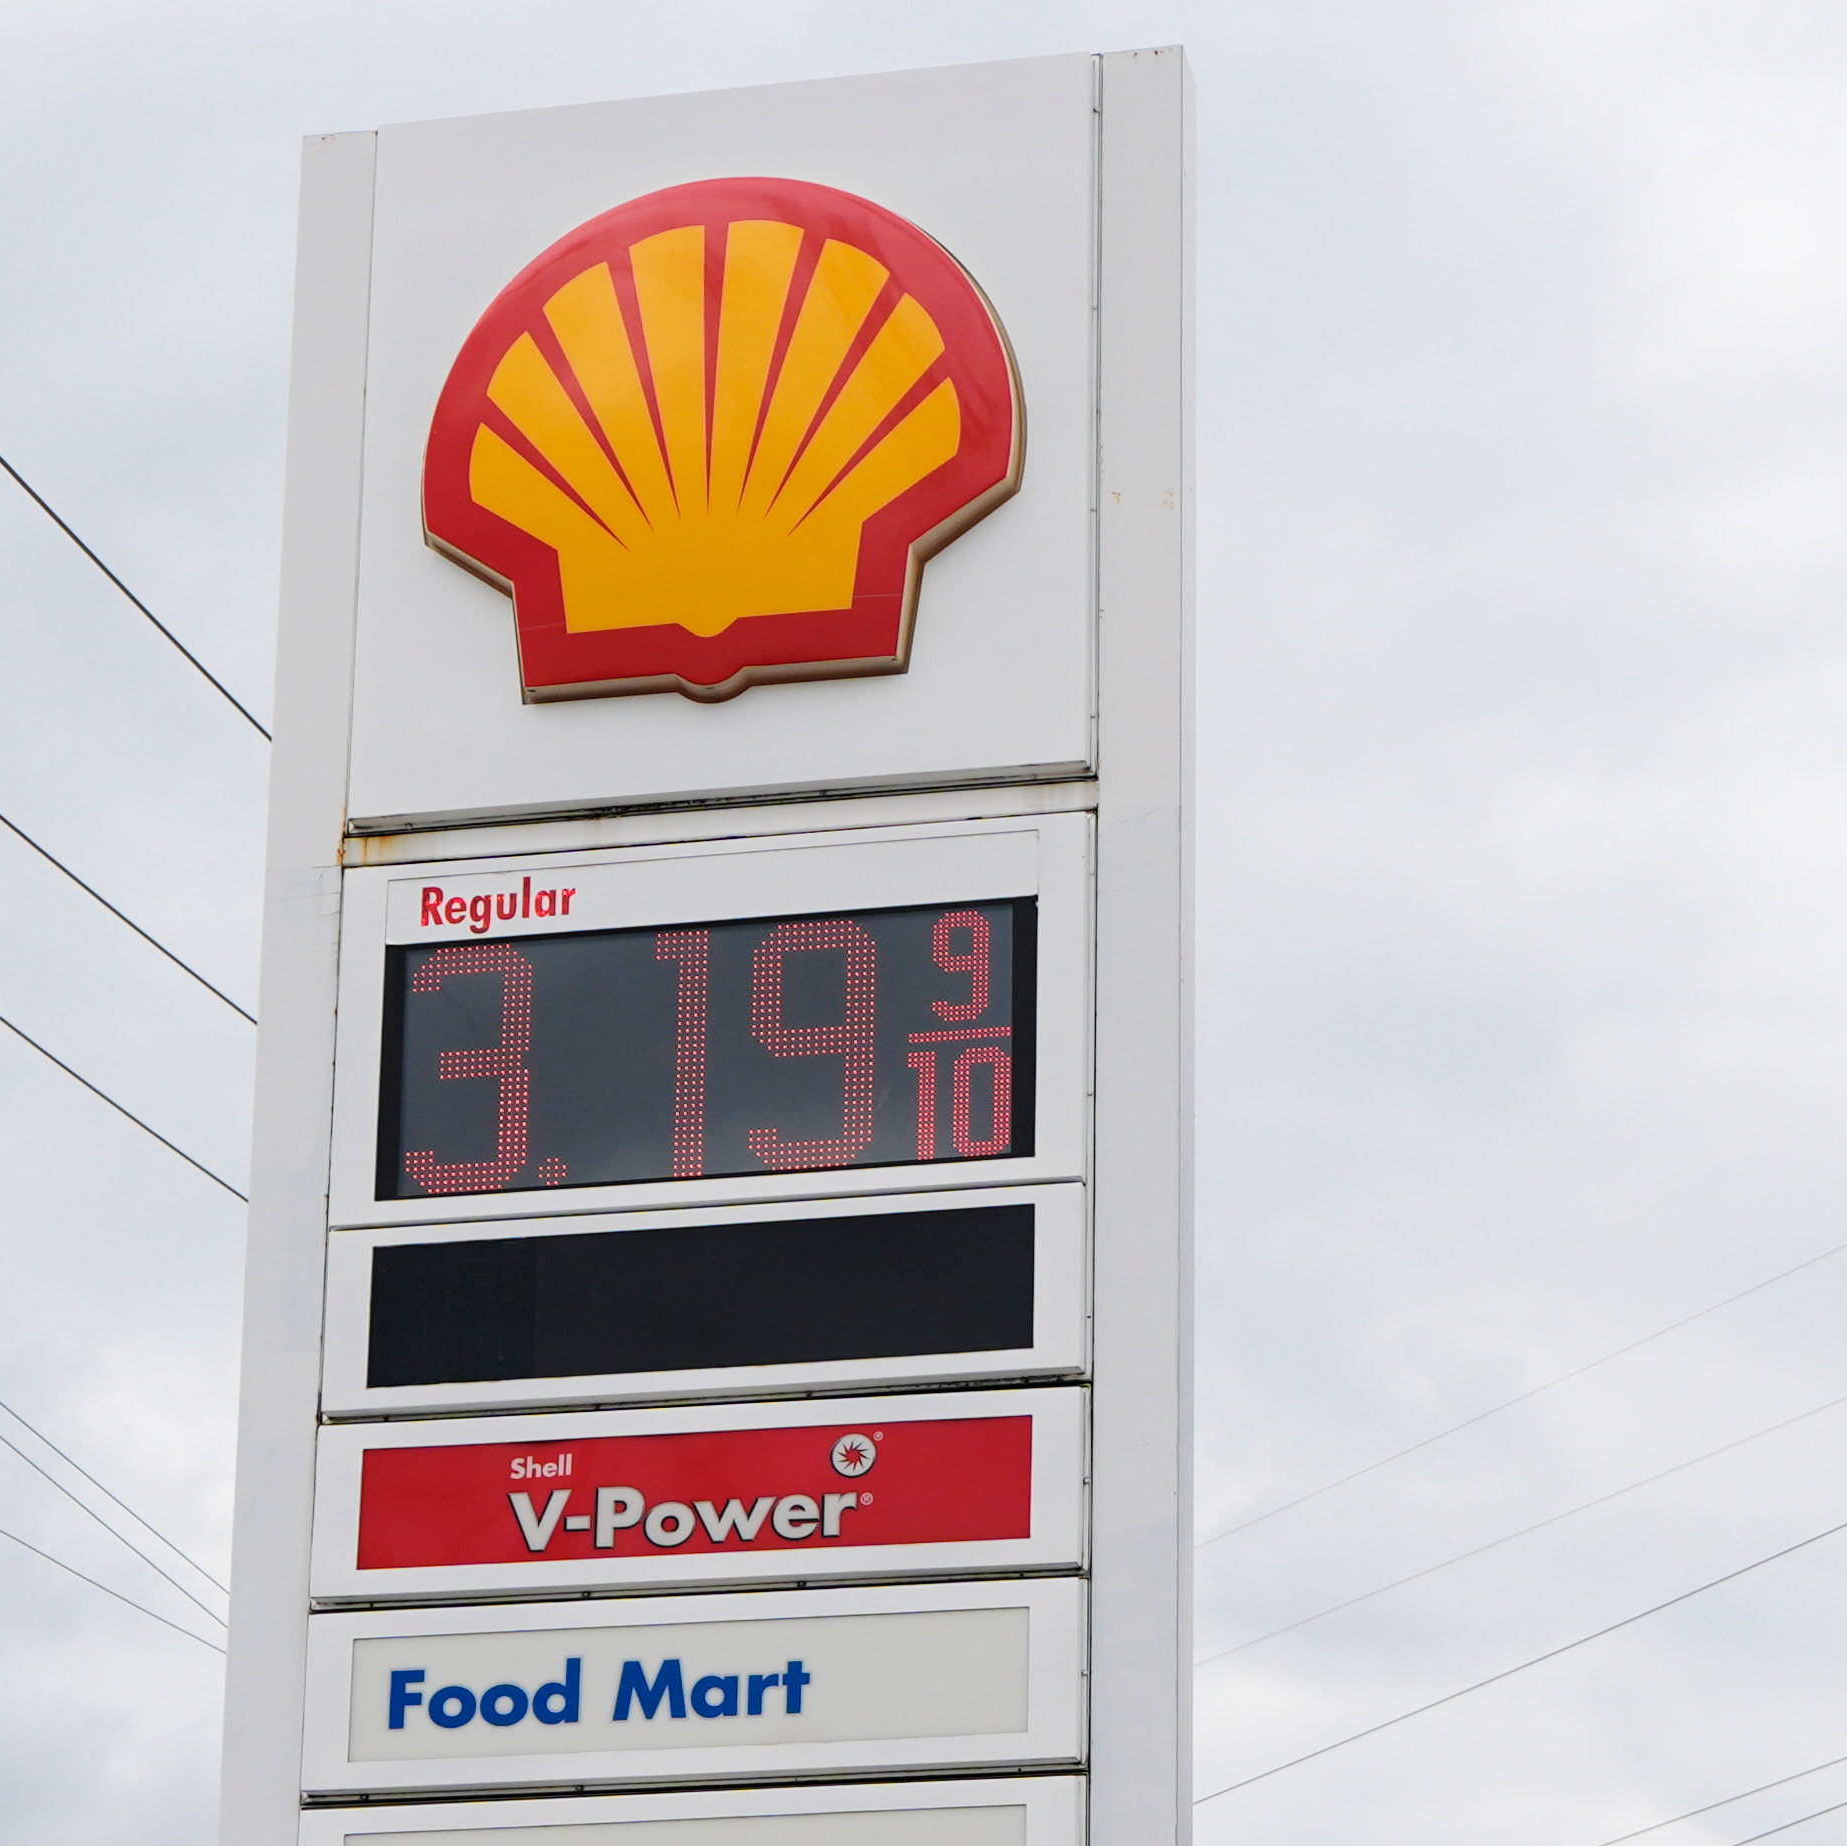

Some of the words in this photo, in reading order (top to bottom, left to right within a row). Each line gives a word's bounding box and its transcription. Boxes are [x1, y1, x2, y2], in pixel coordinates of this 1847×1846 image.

[420, 876, 576, 935] Regular
[509, 1452, 574, 1481] Shell
[387, 1656, 582, 1731] Food
[611, 1657, 813, 1722] Mart
